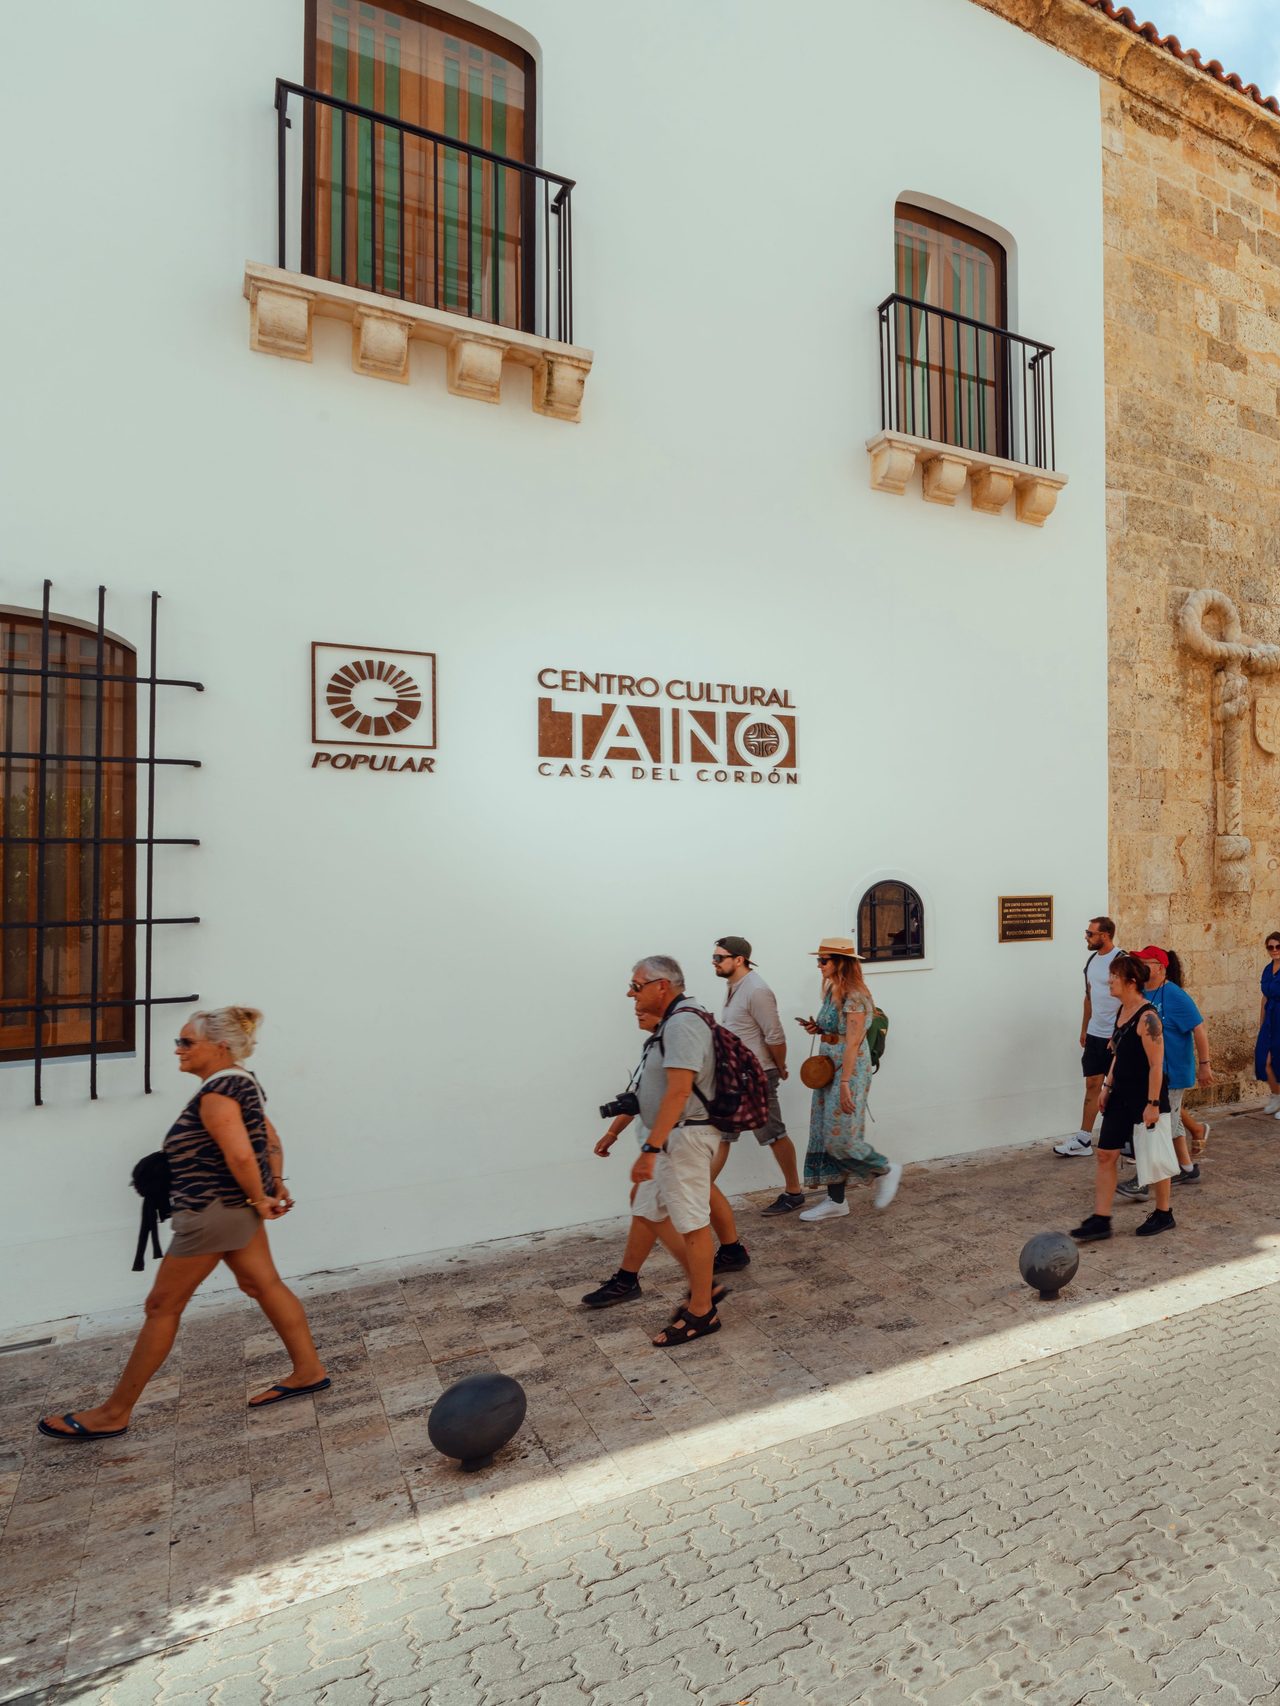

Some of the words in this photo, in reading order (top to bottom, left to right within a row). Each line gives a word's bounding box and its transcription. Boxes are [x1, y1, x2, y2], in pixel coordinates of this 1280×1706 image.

[537, 668, 660, 698] CENTRO
[665, 679, 796, 708] CULTURAL
[538, 697, 797, 768] TAINO
[311, 752, 435, 773] POPULAR
[538, 762, 614, 779] CASA
[632, 766, 680, 781] DEL
[697, 768, 798, 785] CORDÓN
